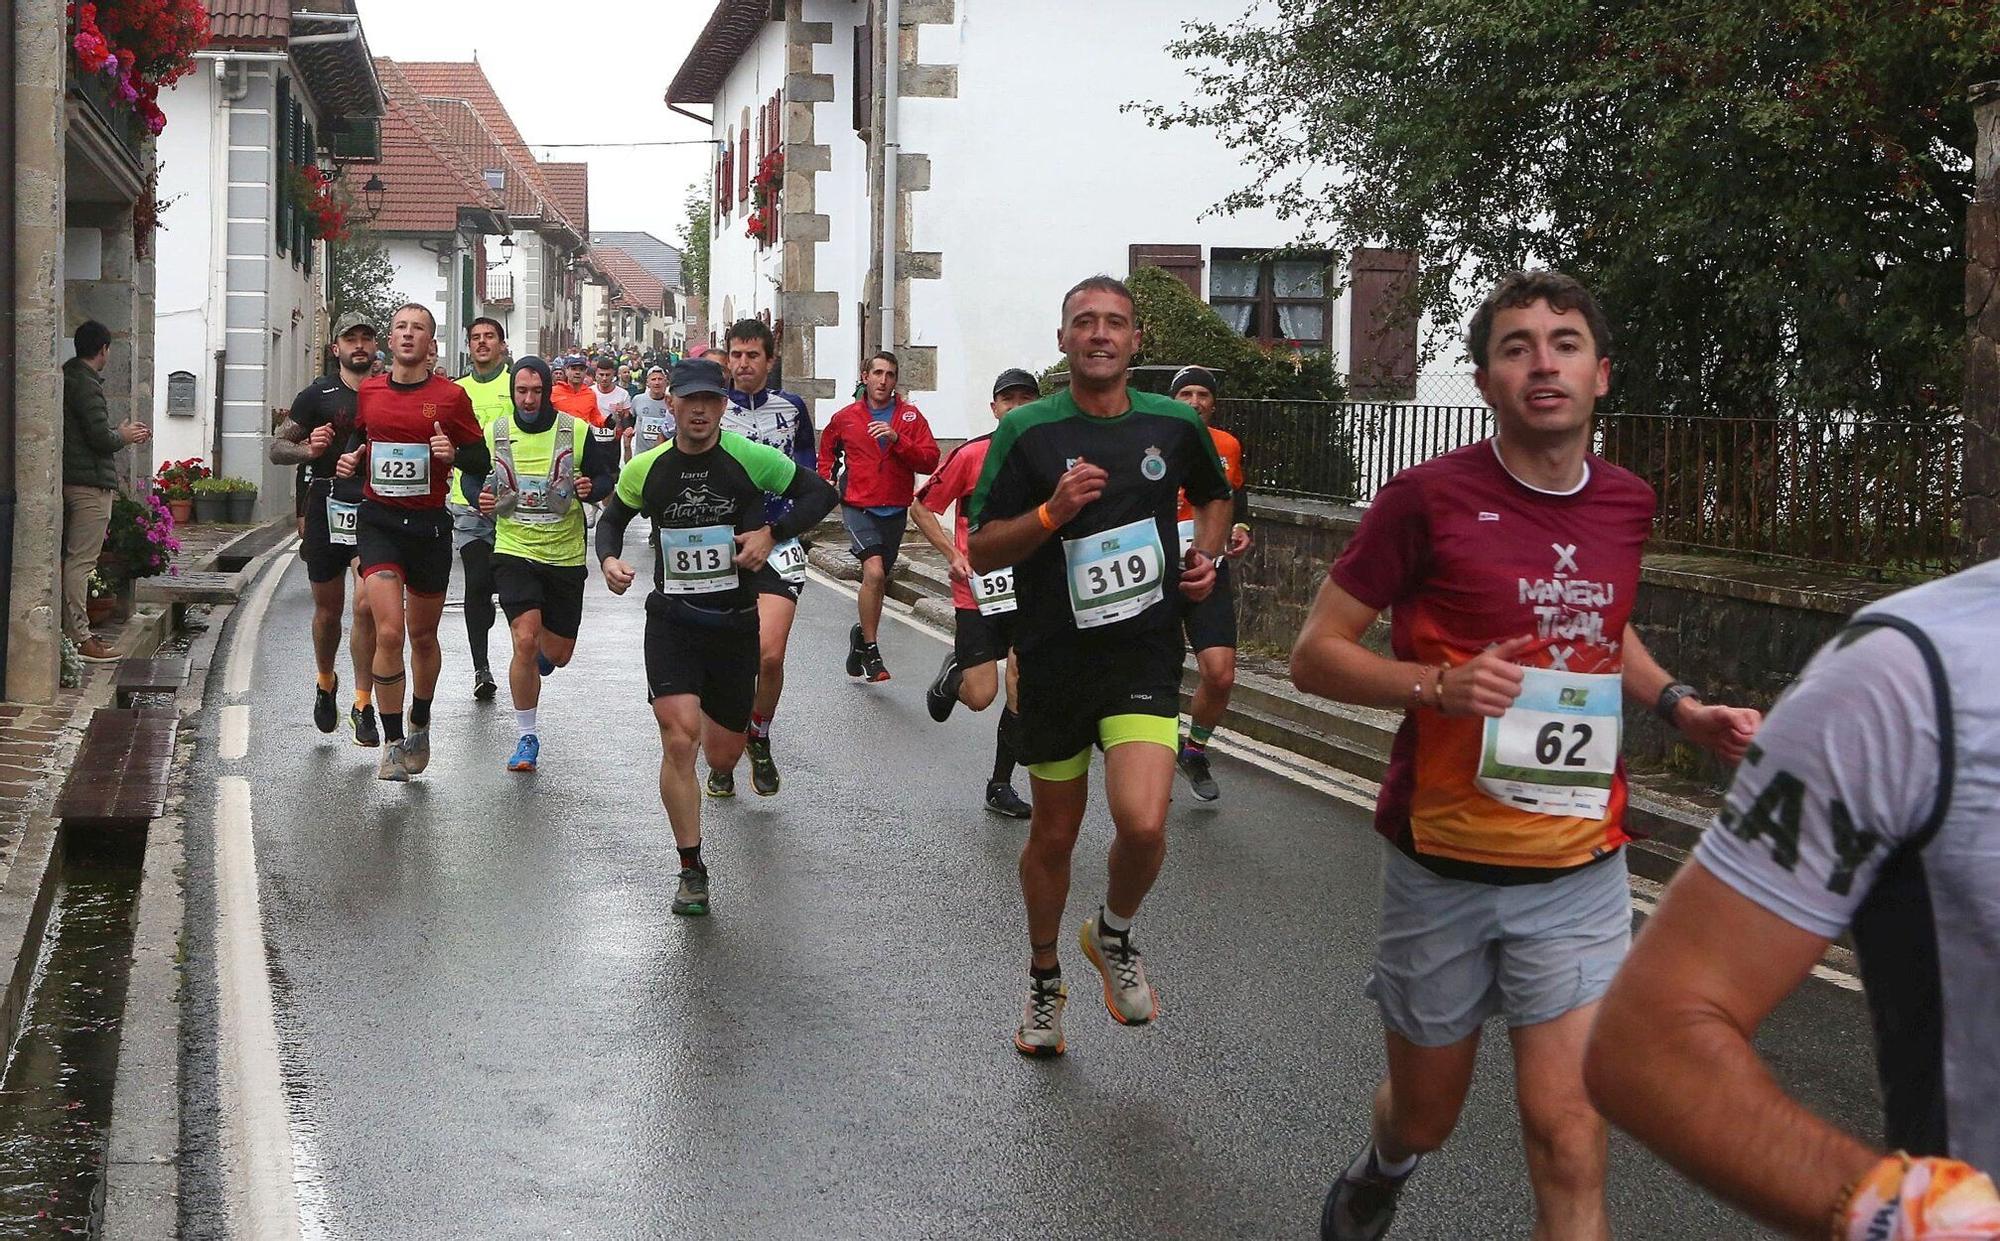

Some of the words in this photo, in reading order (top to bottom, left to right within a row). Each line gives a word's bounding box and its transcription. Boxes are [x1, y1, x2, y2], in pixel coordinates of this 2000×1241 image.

[381, 461, 416, 478] 423
[681, 470, 709, 479] land
[676, 549, 721, 572] 813
[1088, 555, 1147, 595] 319
[1536, 721, 1593, 767] 62
